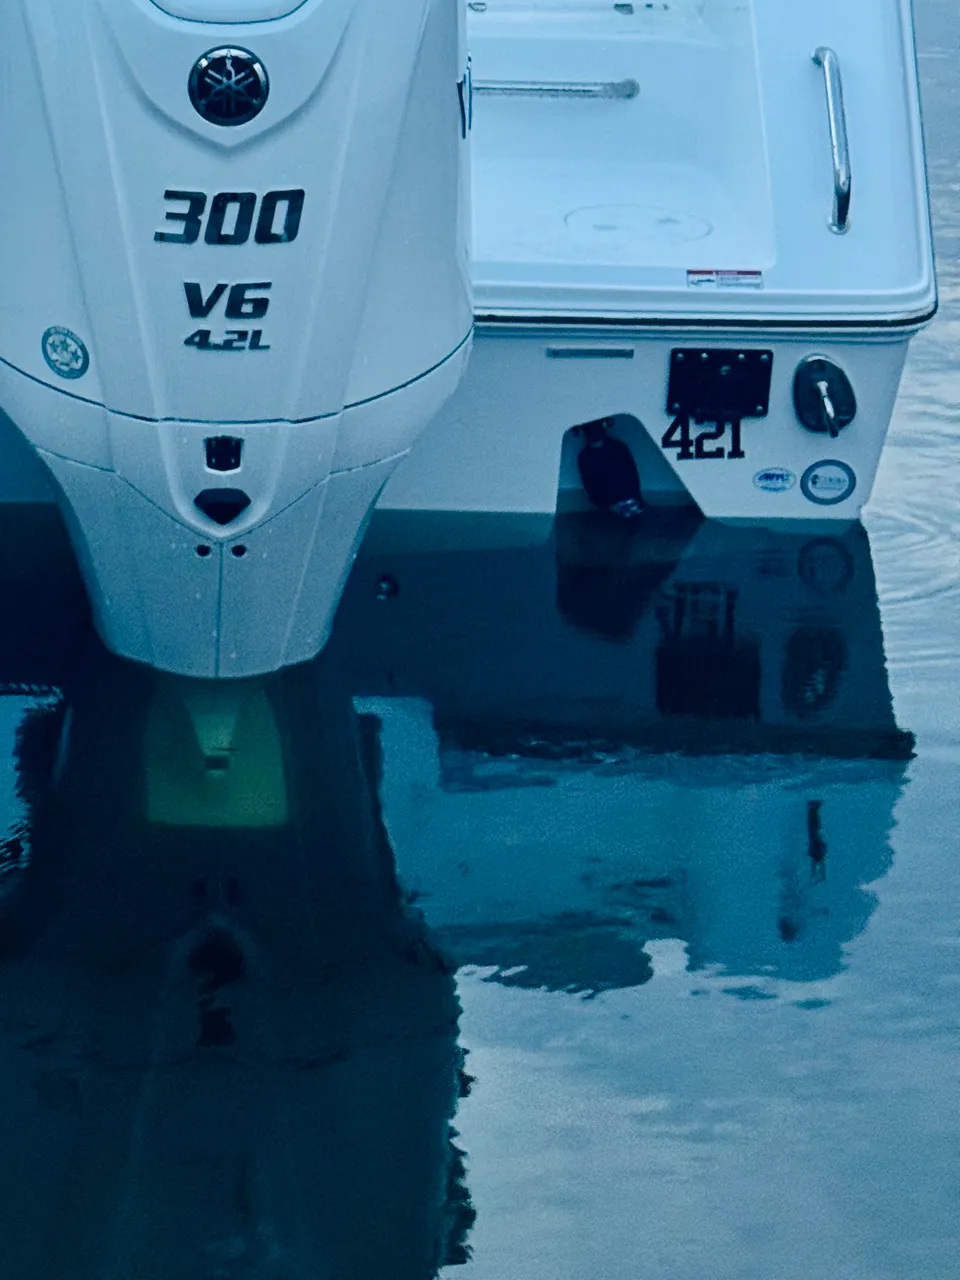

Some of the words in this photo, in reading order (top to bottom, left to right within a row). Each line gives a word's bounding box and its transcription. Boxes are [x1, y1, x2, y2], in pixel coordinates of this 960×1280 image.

[153, 188, 306, 246] 300
[183, 281, 273, 320] V6
[183, 329, 271, 352] 4.2L
